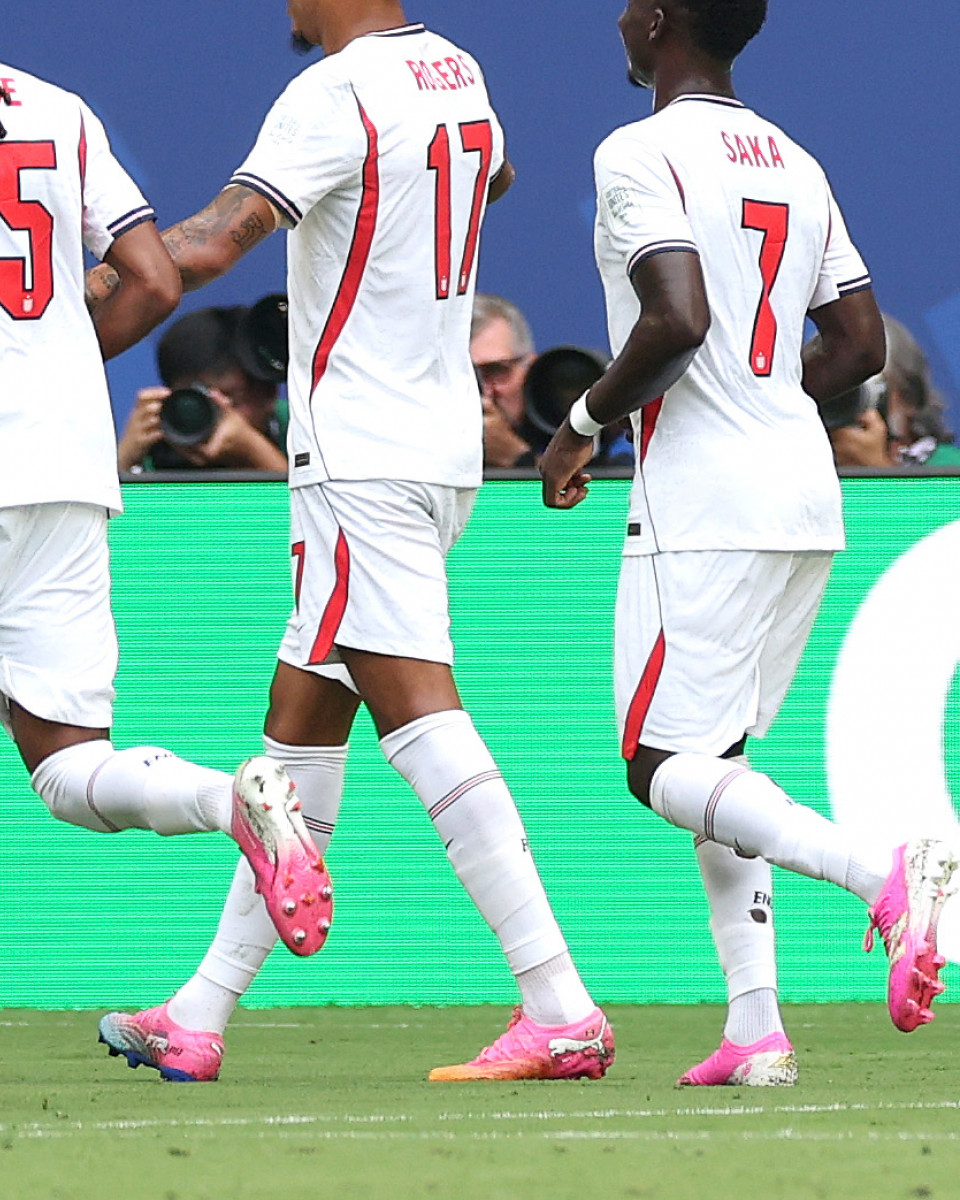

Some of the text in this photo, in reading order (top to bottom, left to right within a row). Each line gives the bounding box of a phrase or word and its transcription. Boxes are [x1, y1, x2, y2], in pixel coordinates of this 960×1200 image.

[406, 54, 475, 90] ROGERS
[721, 131, 785, 169] SAKA
[427, 119, 493, 300] 17
[741, 198, 789, 377] 7
[753, 891, 771, 906] EN
